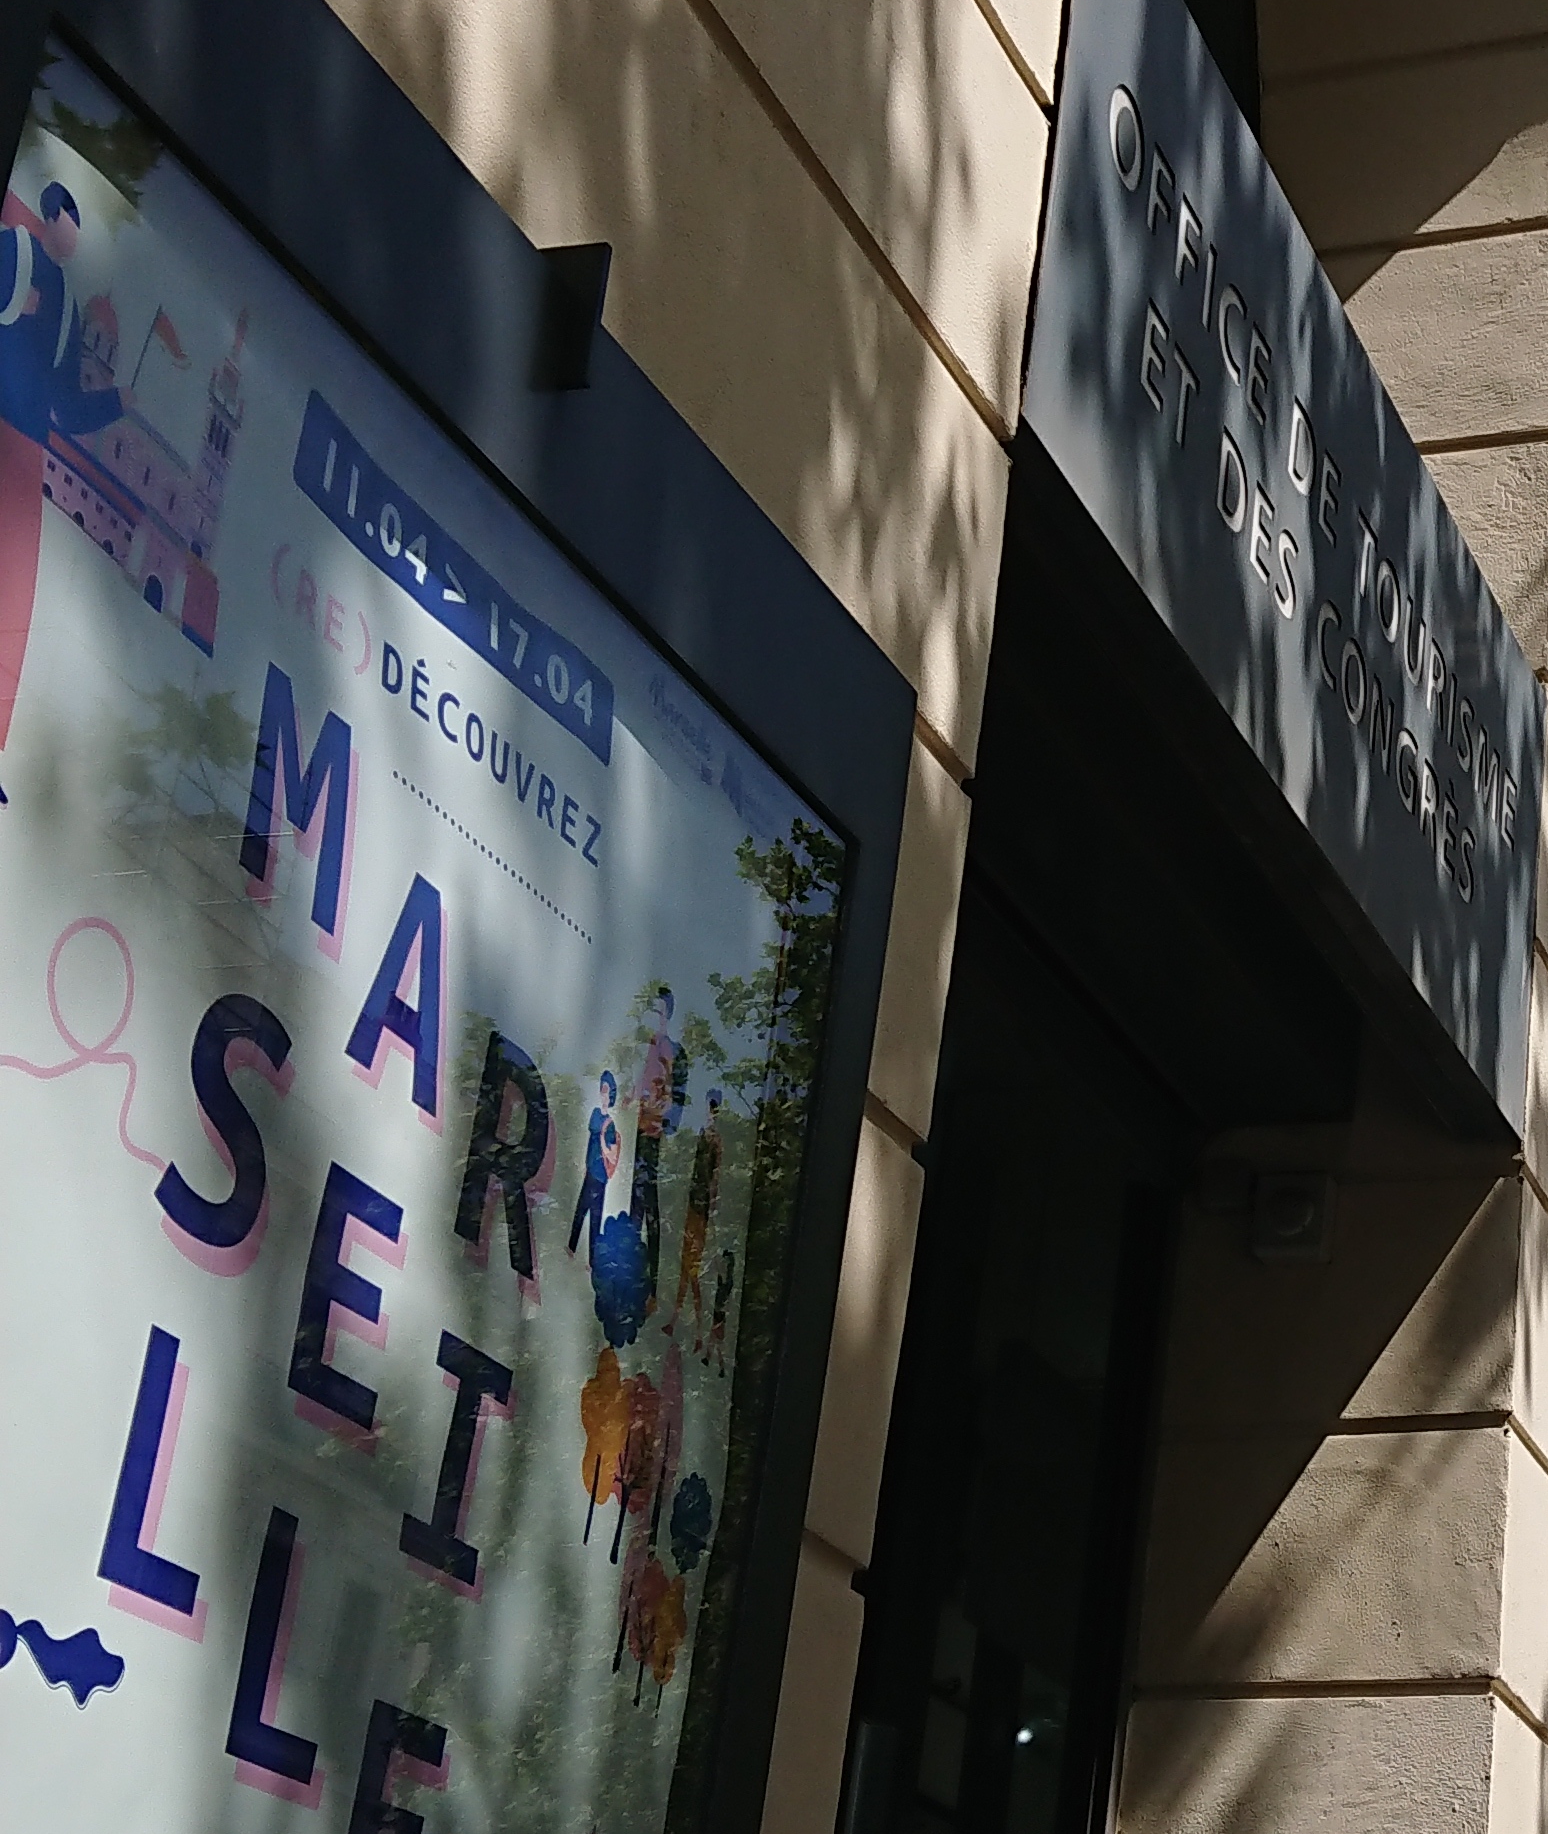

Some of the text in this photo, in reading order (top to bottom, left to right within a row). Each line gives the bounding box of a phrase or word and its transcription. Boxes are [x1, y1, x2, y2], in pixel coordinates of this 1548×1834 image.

[323, 438, 427, 586] 11.04
[490, 602, 593, 727] 17.04
[1106, 83, 1520, 855] OFFICE DE TOURISME
[1138, 297, 1478, 906] ET DES CONGRÈS
